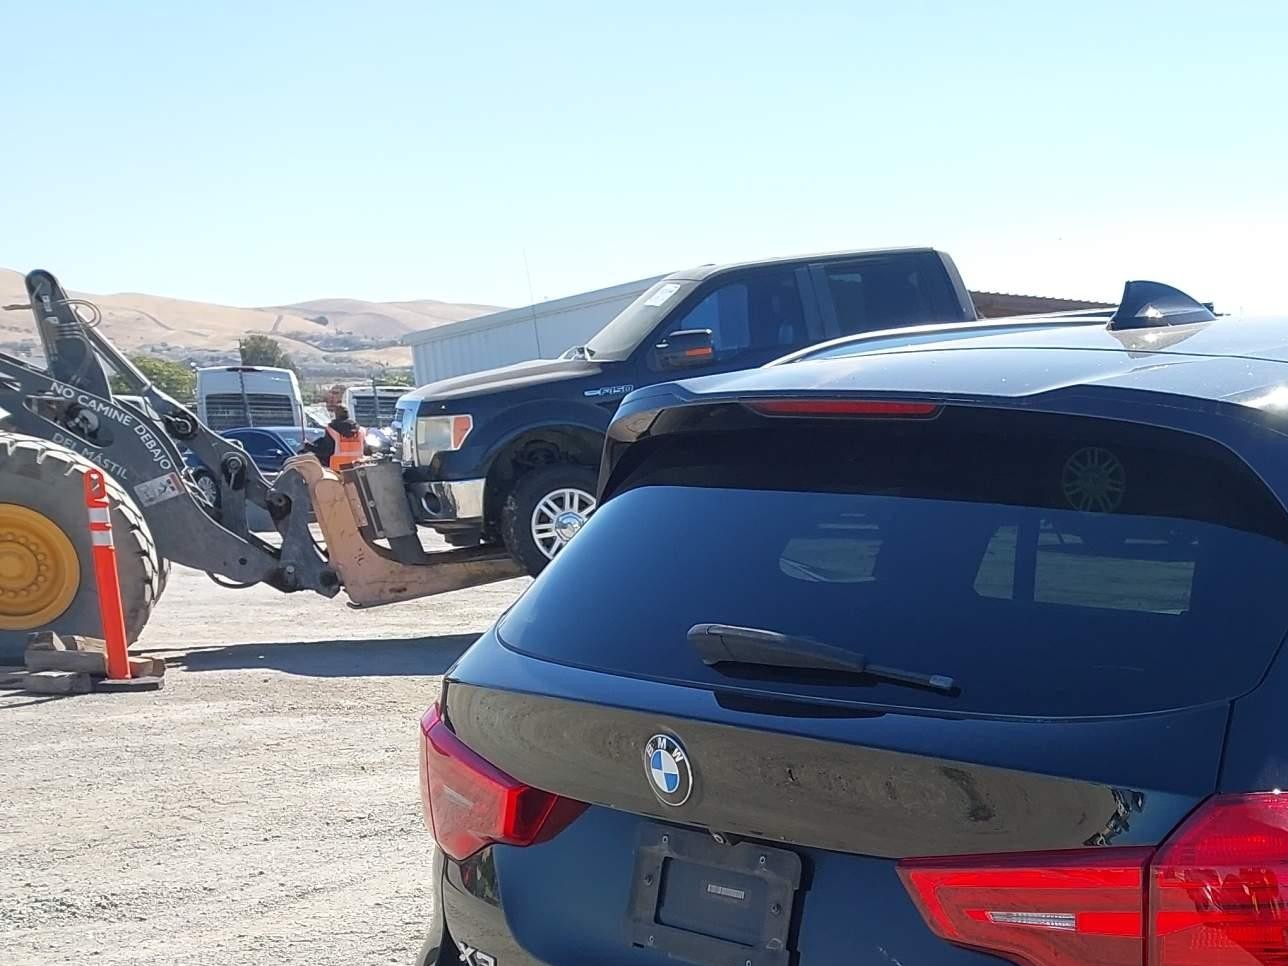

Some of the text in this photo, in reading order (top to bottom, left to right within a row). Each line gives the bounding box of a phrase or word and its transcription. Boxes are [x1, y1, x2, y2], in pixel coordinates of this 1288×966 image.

[50, 382, 172, 470] NO CAMINE DEBAJO
[80, 447, 128, 480] MÁSTIL
[646, 737, 684, 762] BMW
